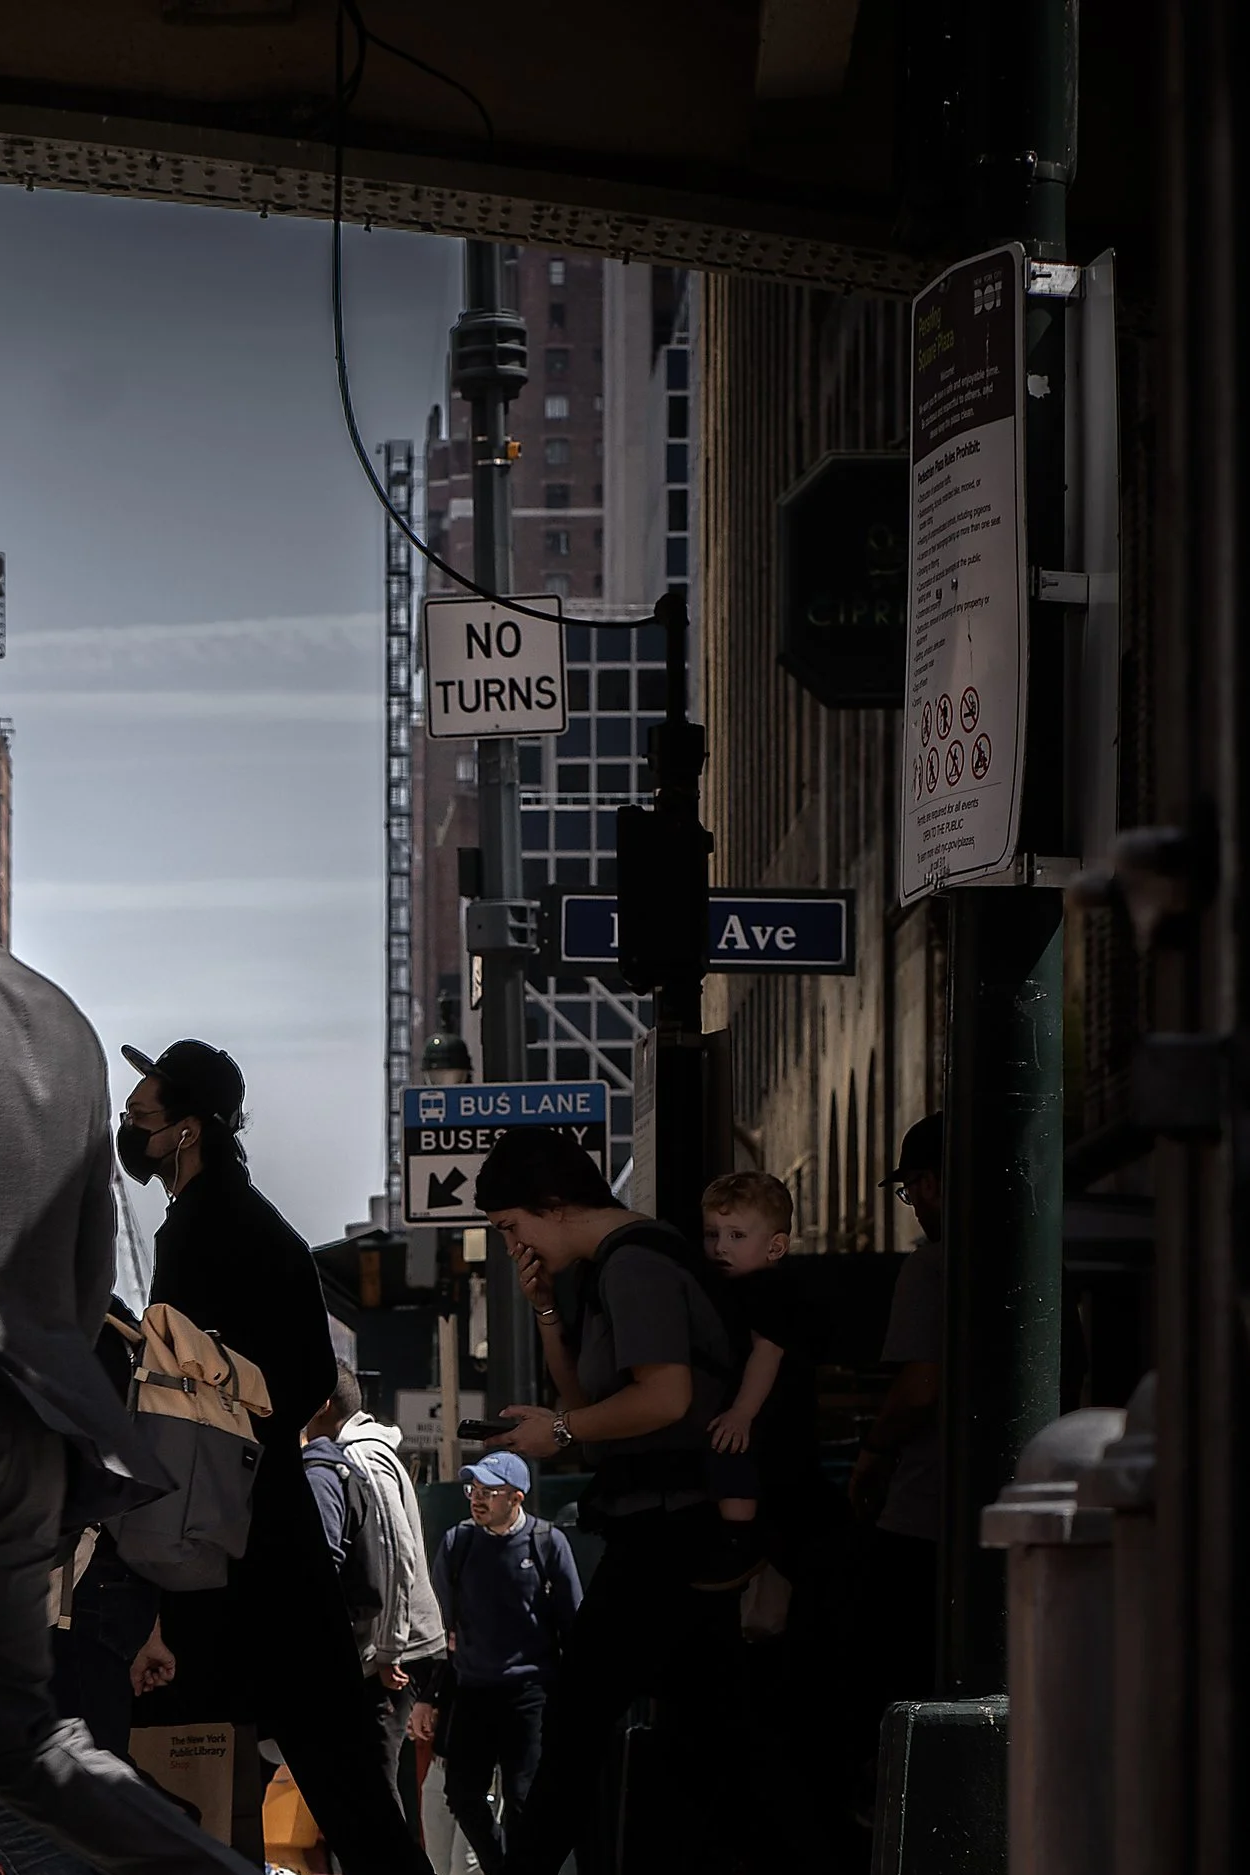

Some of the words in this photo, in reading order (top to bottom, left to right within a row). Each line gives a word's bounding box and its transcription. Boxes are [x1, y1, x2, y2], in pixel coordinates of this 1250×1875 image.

[973, 280, 1003, 316] DOT
[937, 329, 955, 358] Plaza
[973, 503, 992, 519] pigeons
[971, 523, 981, 534] than
[981, 519, 990, 530] one
[990, 515, 1001, 527] seat
[466, 621, 521, 659] NO
[435, 676, 557, 714] TURNS
[961, 798, 979, 811] events
[945, 817, 964, 834] PUBLIC
[717, 914, 798, 951] Ave
[459, 1095, 512, 1116] BUS
[521, 1093, 592, 1114] LANE
[171, 1736, 185, 1746] The
[187, 1735, 205, 1744] New
[206, 1733, 227, 1743] York
[170, 1747, 193, 1757] Public
[194, 1746, 226, 1757] Library
